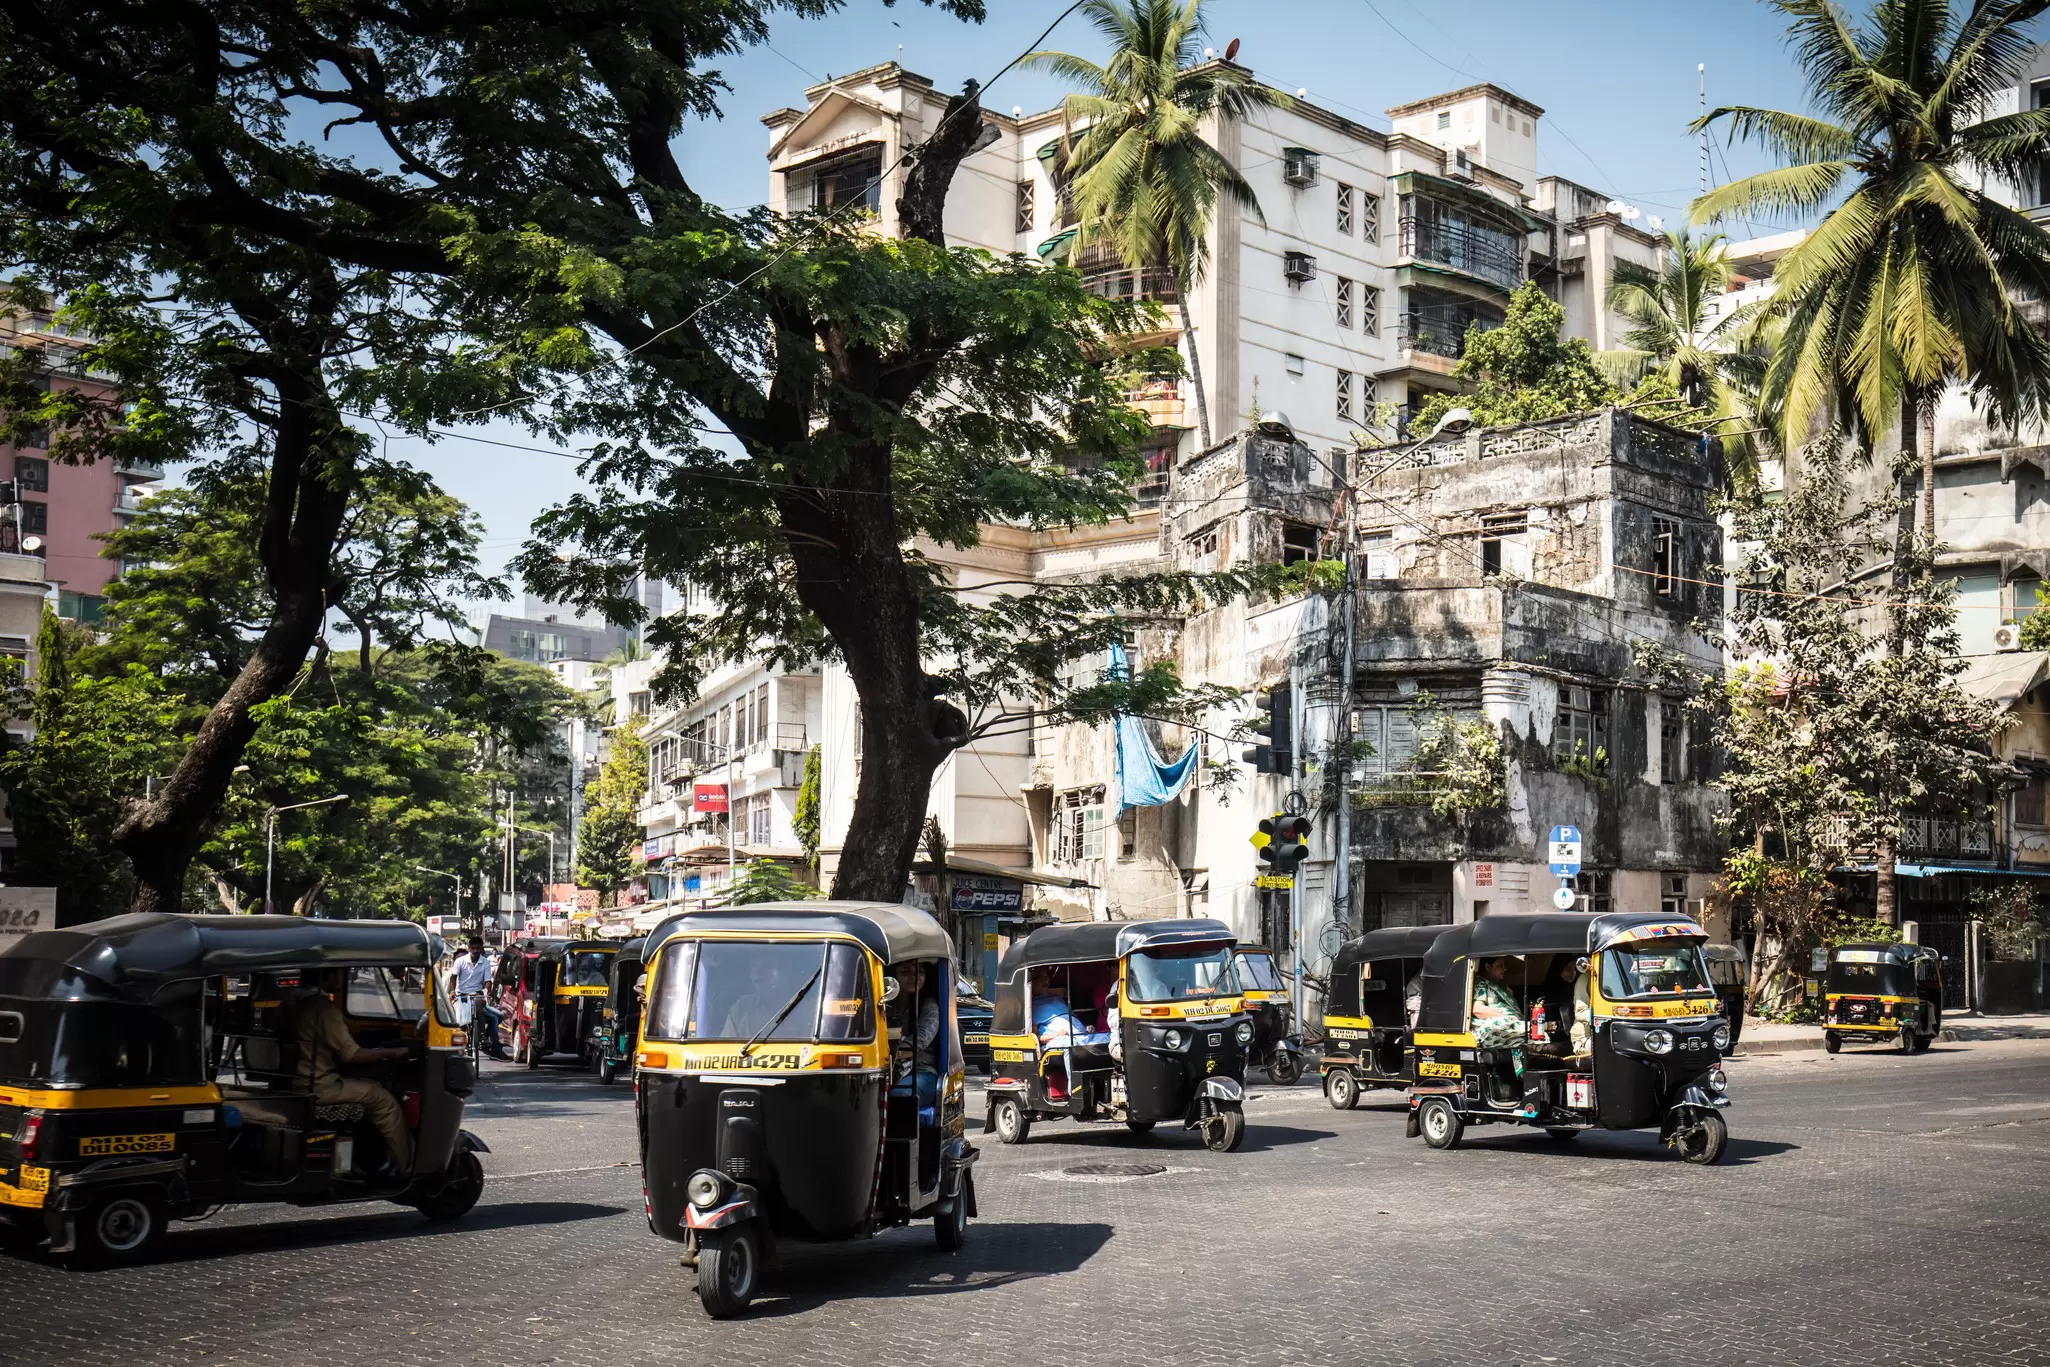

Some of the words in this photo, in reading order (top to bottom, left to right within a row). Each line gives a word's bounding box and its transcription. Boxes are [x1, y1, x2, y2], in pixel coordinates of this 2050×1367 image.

[1561, 828, 1572, 842] P
[976, 880, 1003, 889] CENTRE
[971, 893, 1021, 906] PEPSI
[1686, 1005, 1708, 1015] 5426
[1421, 1069, 1460, 1077] 5426
[723, 1100, 755, 1108] BAJAJ
[90, 1137, 135, 1145] MH
[138, 1134, 167, 1142] 02
[82, 1141, 172, 1155] DU0085
